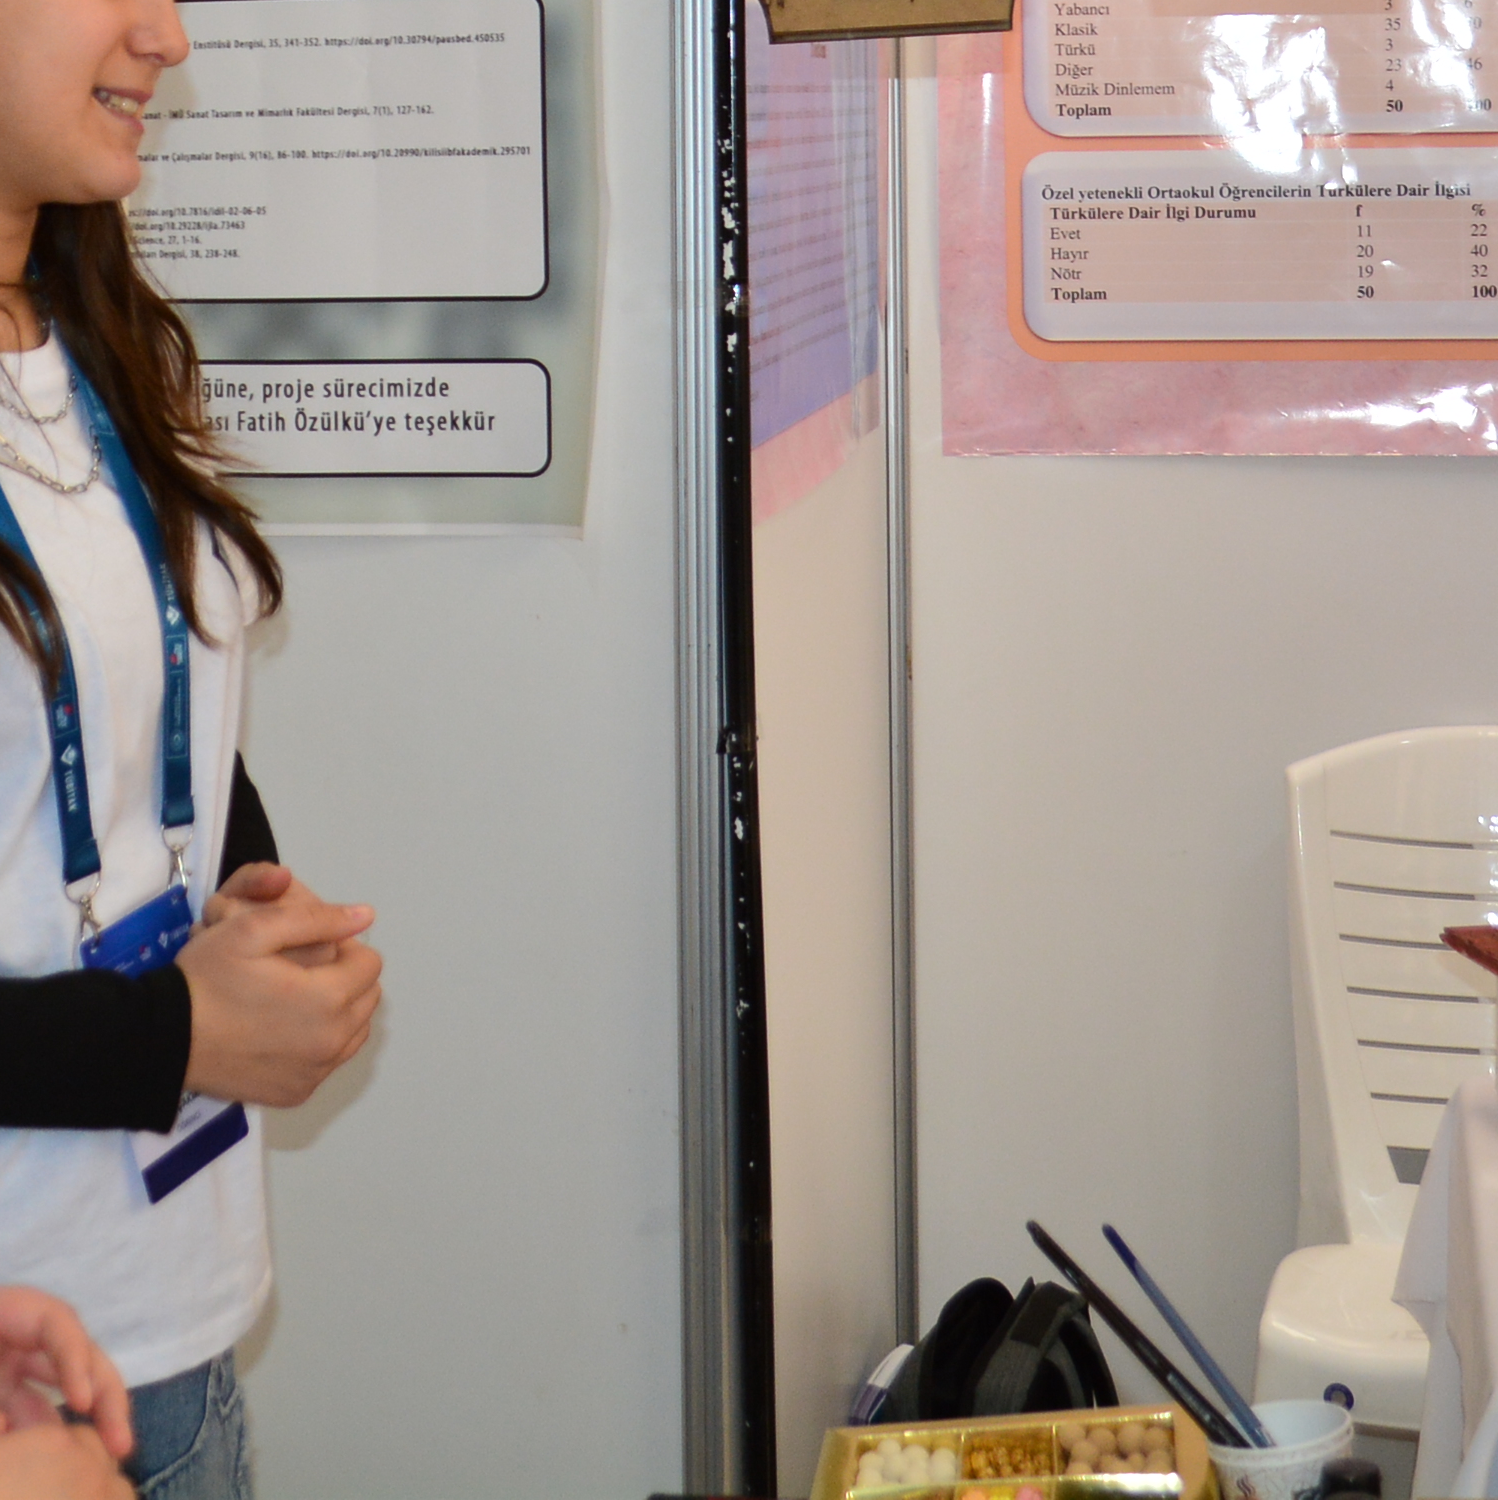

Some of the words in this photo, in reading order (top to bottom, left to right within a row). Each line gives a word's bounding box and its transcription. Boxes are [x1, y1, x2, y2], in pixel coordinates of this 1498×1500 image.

[1042, 185, 1073, 200] Özel
[1079, 187, 1142, 203] yetenekli
[1148, 186, 1214, 199] Ortaokul
[1219, 183, 1311, 201] Öğrencilerin
[1397, 184, 1429, 196] Dair
[1435, 181, 1470, 200] İlgisi
[1051, 227, 1080, 240] Evet
[1358, 225, 1371, 237] 11
[1471, 224, 1487, 236] 22
[1051, 248, 1089, 263] Hayır
[1357, 245, 1373, 257] 20
[1470, 245, 1488, 257] 40
[1051, 267, 1082, 280] Nötr
[1359, 265, 1374, 278] 19
[1471, 265, 1488, 277] 32
[1051, 288, 1107, 303] Toplam
[1357, 286, 1374, 298] 50
[1474, 286, 1497, 297] 100
[238, 411, 285, 431] Fatih
[405, 411, 495, 436] teşekkür
